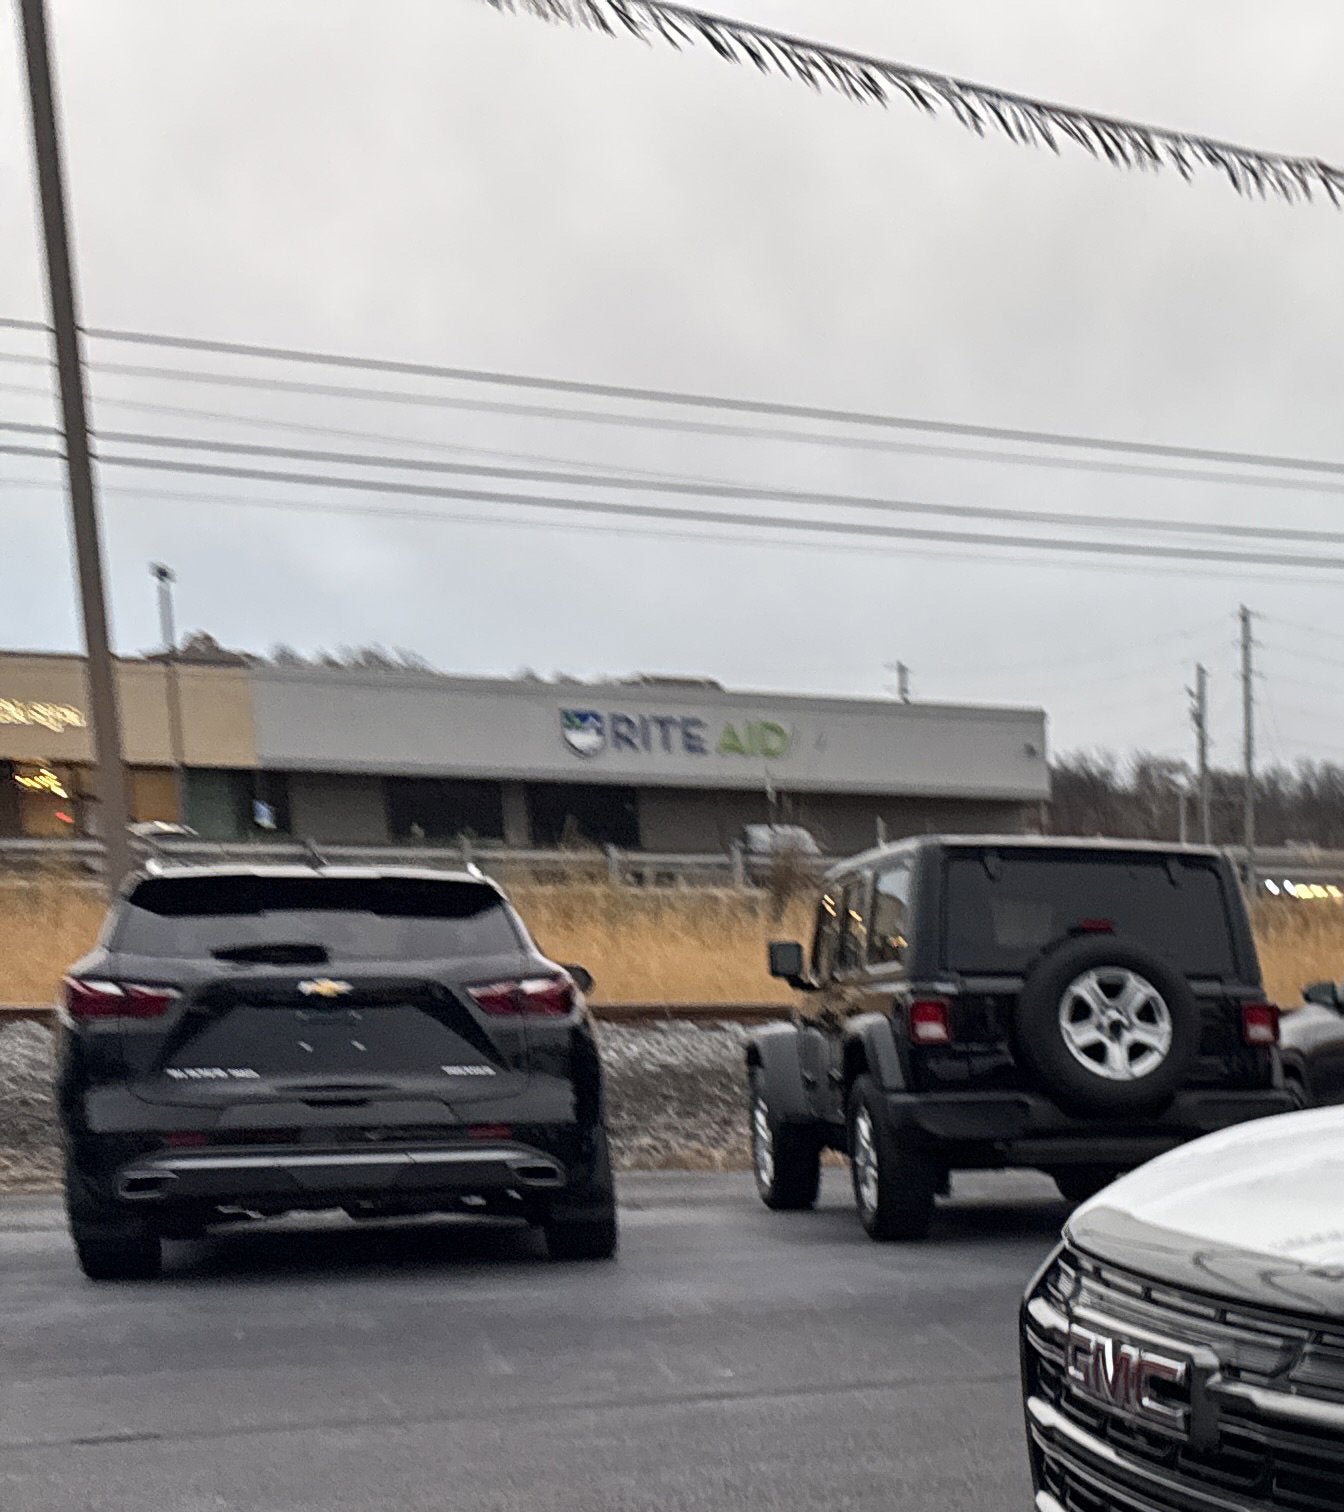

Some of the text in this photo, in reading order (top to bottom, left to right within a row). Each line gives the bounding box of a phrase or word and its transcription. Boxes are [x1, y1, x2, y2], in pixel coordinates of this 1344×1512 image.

[607, 711, 791, 759] RITE AID
[1068, 1324, 1186, 1438] GMC
